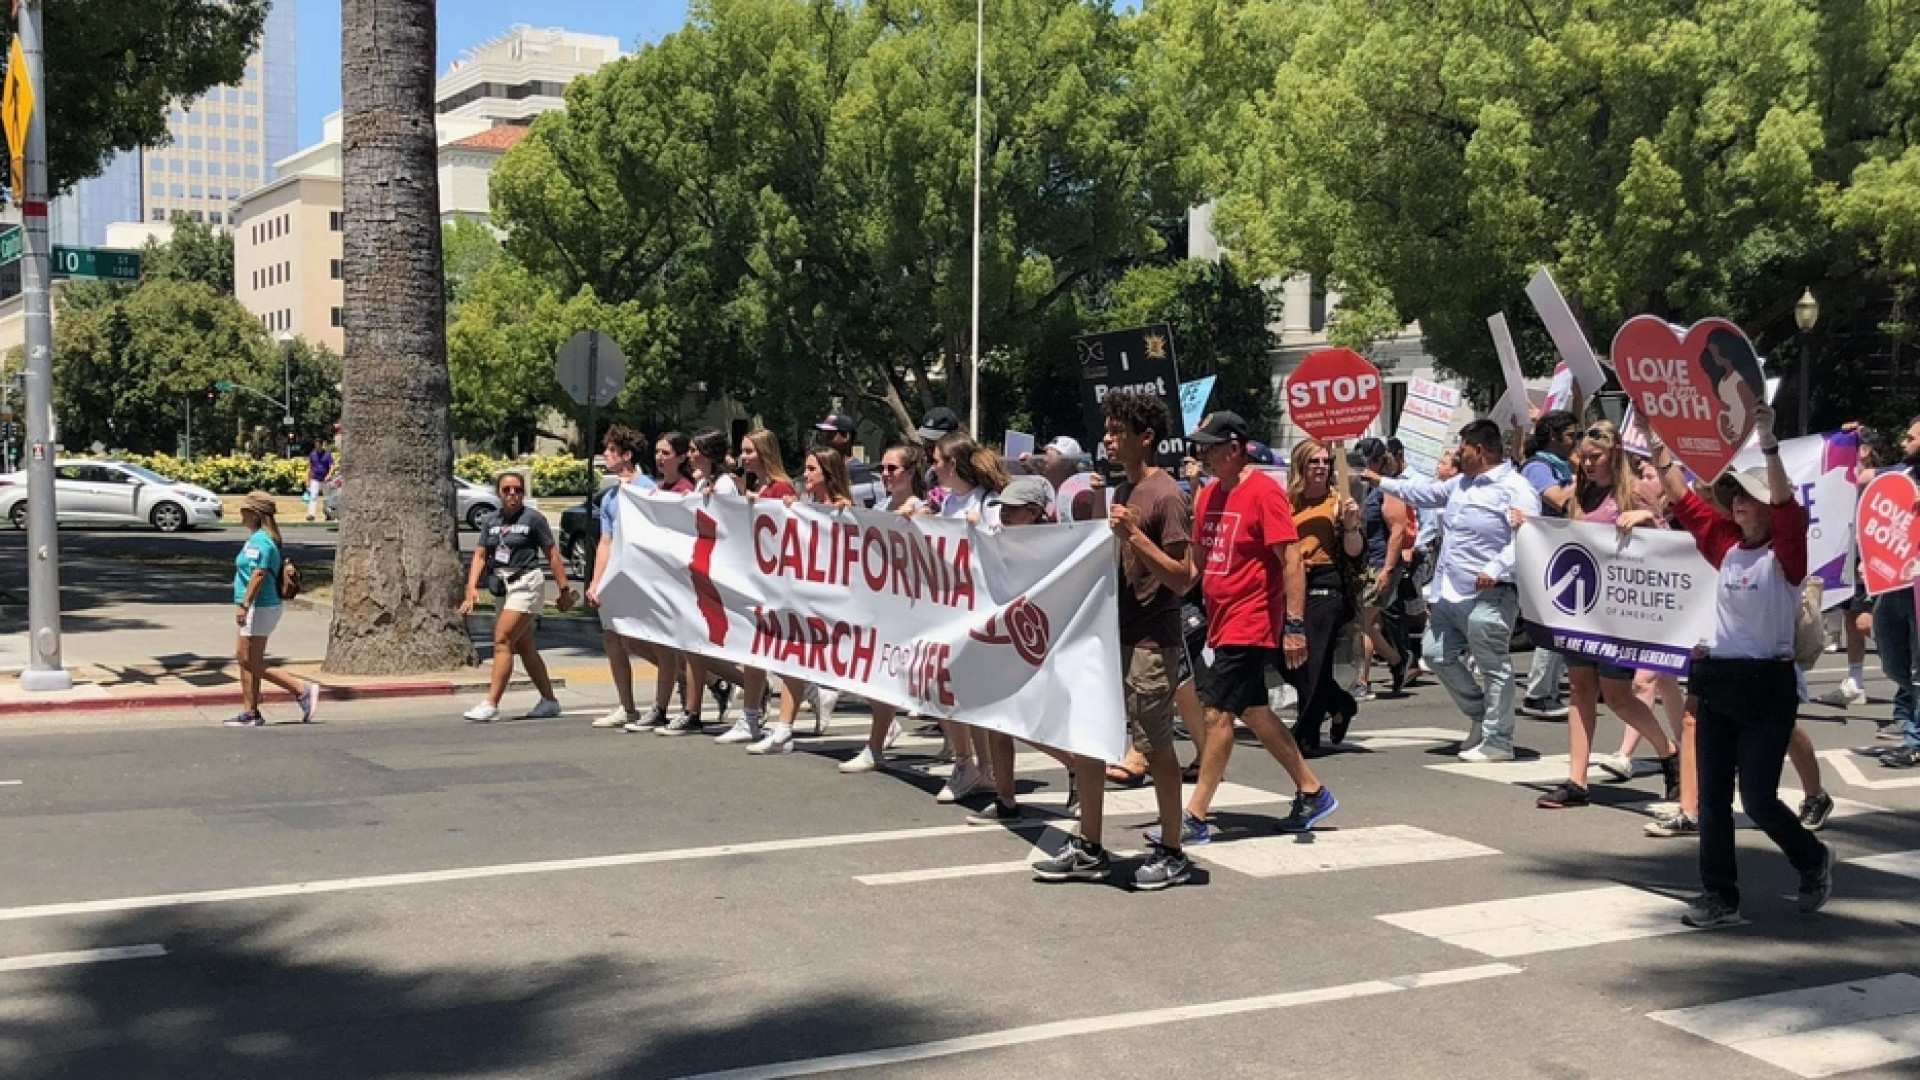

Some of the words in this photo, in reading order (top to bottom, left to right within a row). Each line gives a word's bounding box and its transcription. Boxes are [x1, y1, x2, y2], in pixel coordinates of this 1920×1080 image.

[57, 252, 79, 272] 10
[1120, 351, 1129, 371] I
[1626, 357, 1691, 385] LOVE
[1290, 373, 1377, 408] STOP
[1642, 391, 1712, 421] BOTH
[1870, 491, 1914, 527] LOVE
[1864, 517, 1912, 560] BOTH
[753, 513, 975, 611] CALIFORNIA
[1606, 565, 1692, 590] STUDENTS
[1606, 586, 1638, 606] FOR
[1641, 591, 1676, 610] LIFE
[1606, 607, 1617, 616] OF
[1620, 609, 1664, 622] AMERICA
[750, 605, 877, 683] MARCH
[880, 643, 908, 678] FOR
[907, 639, 955, 707] LIFE
[1554, 635, 1566, 648] WE
[1566, 637, 1583, 651] ARE
[1583, 640, 1600, 655] THE
